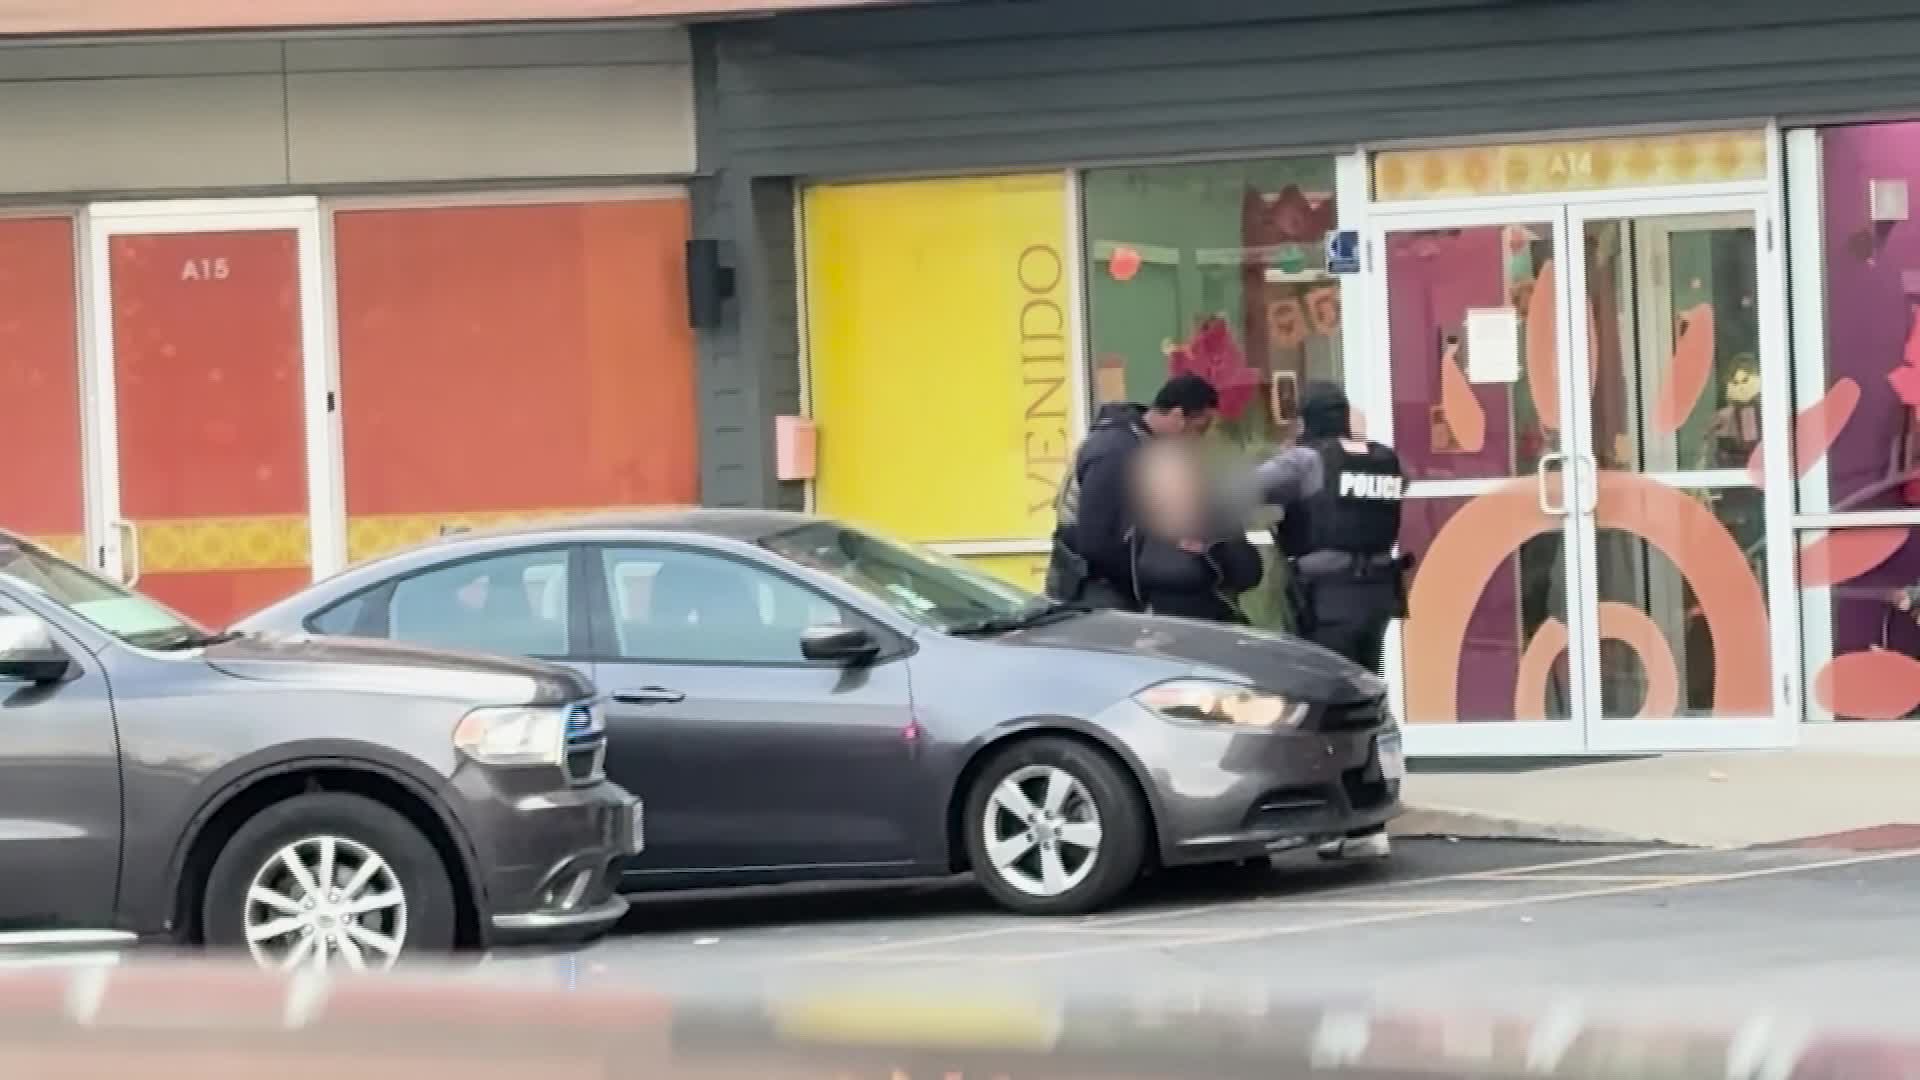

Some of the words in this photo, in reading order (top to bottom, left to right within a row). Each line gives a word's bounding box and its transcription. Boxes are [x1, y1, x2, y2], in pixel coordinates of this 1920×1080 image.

[1544, 151, 1592, 177] A14
[181, 257, 231, 281] A15
[1016, 243, 1069, 577] VENIDO
